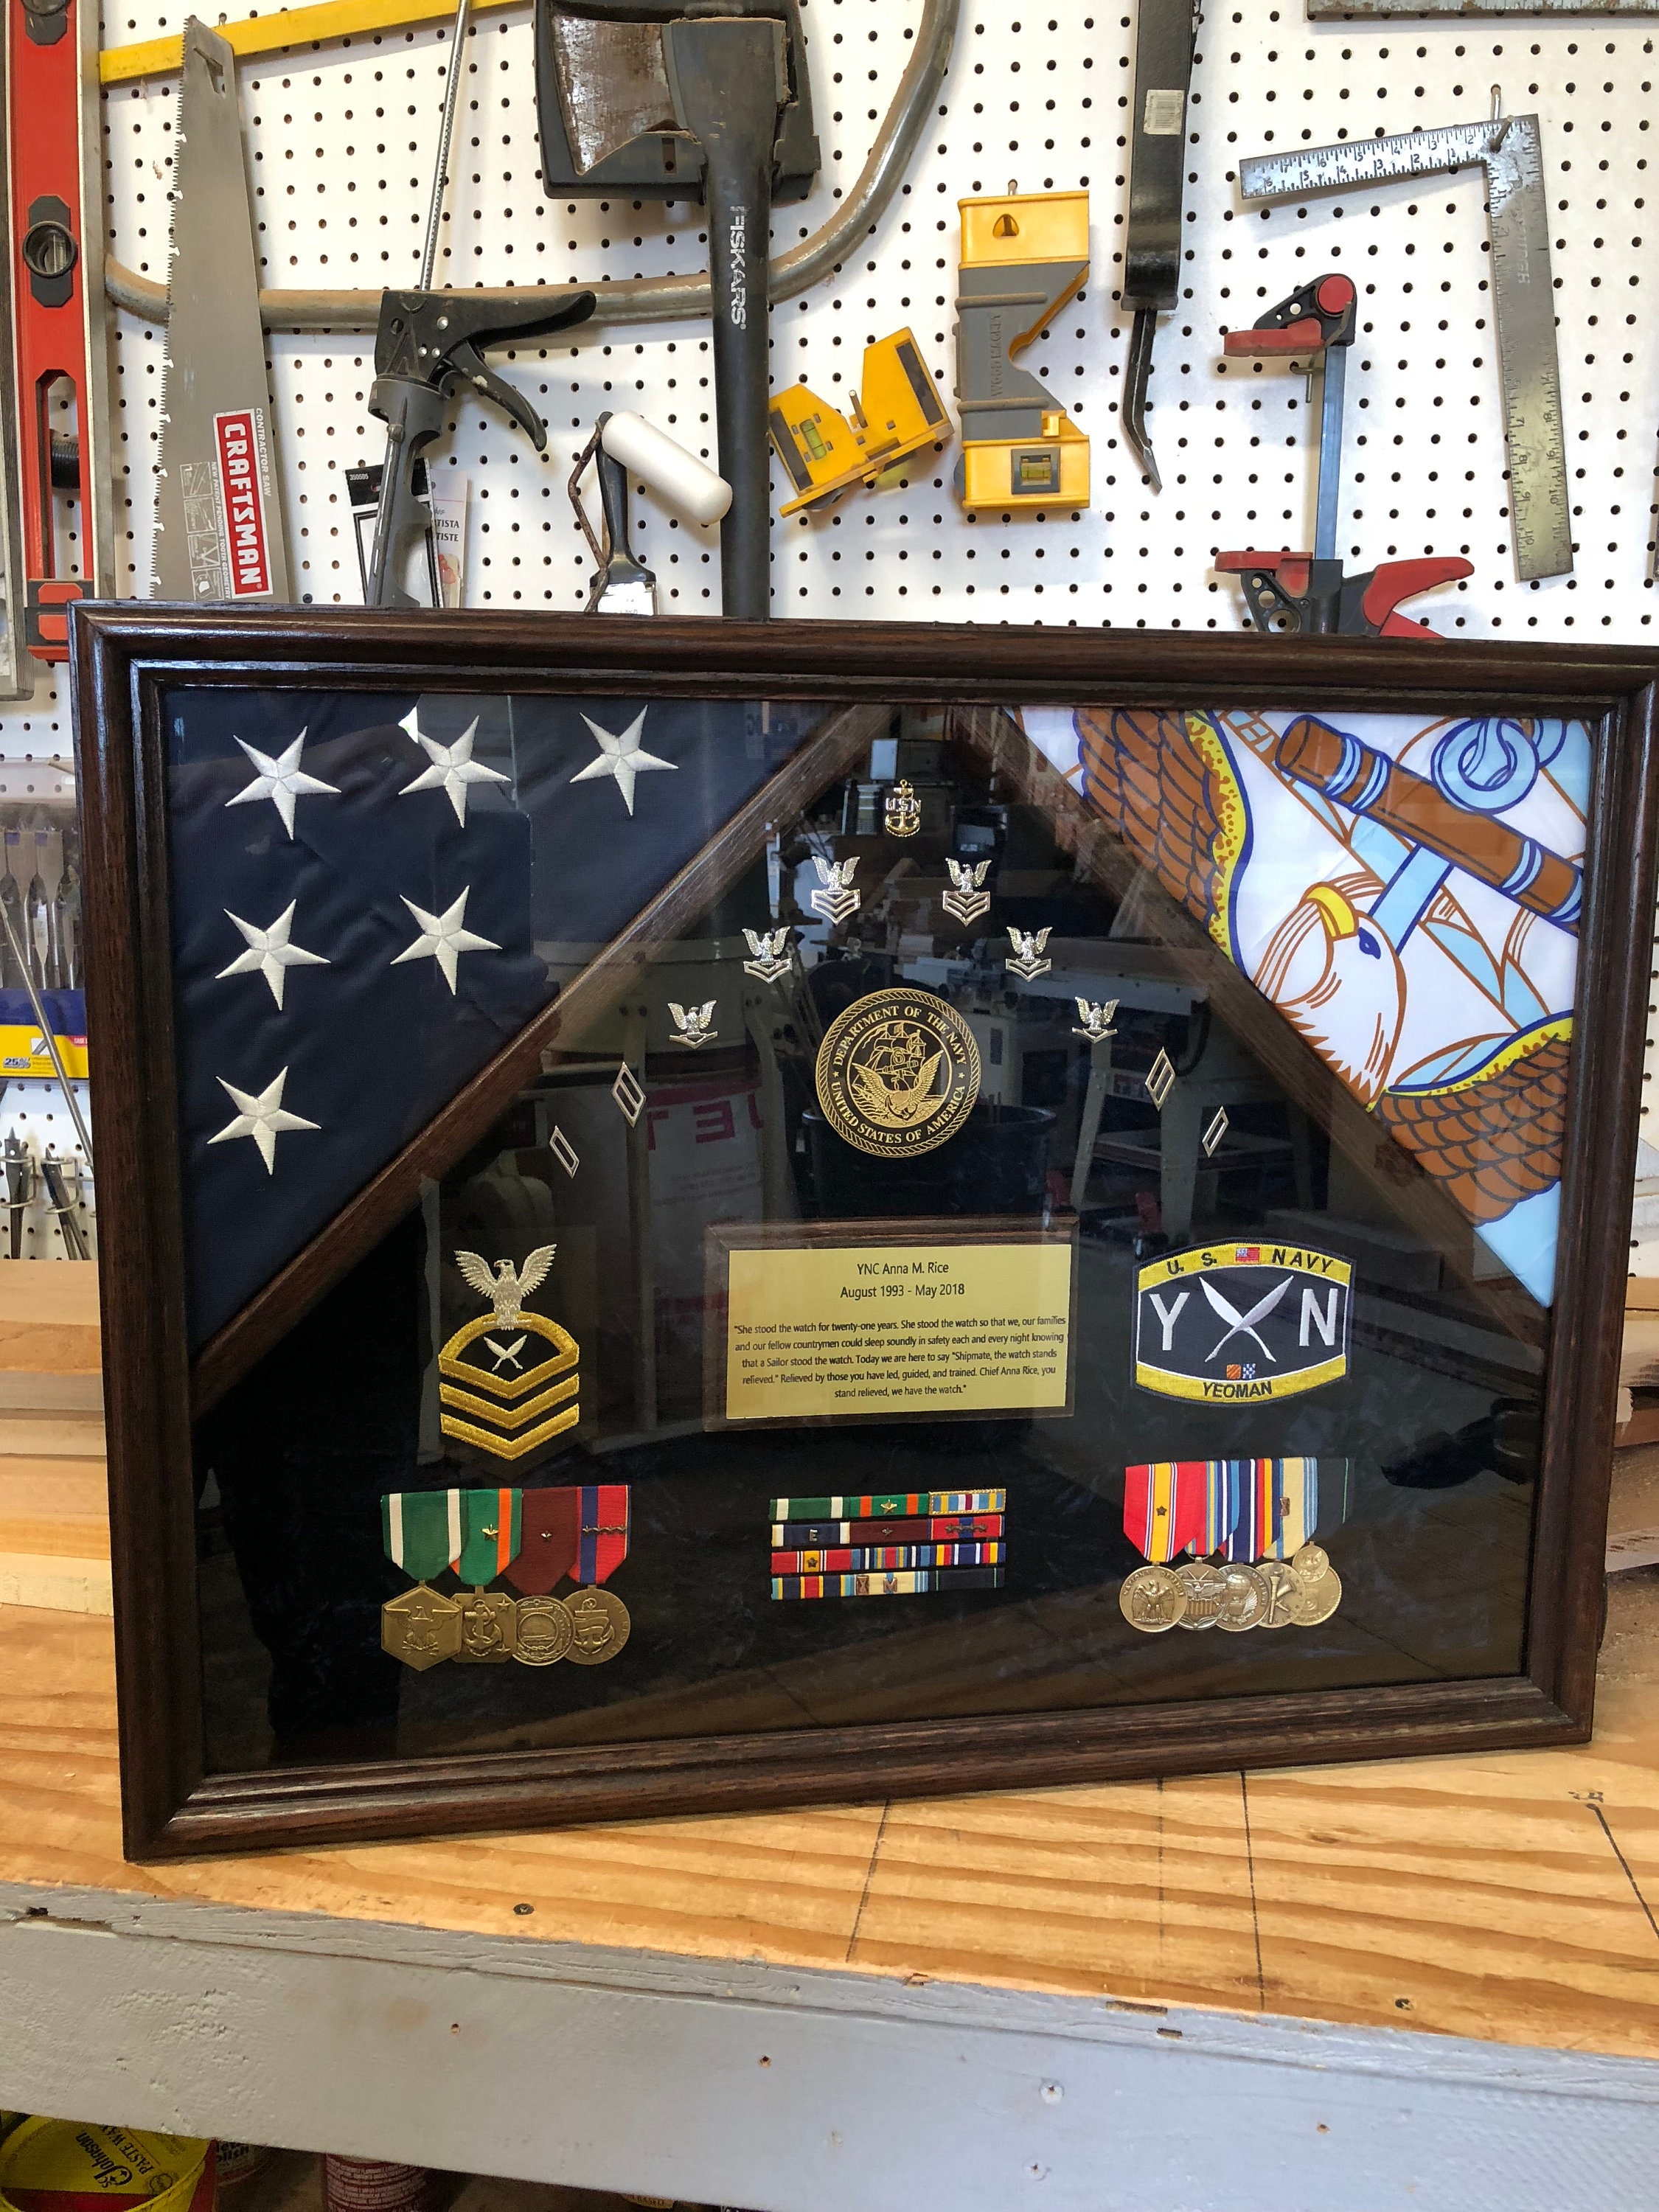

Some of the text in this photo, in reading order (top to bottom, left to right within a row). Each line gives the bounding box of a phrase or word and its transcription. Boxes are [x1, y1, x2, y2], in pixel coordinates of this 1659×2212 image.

[730, 206, 746, 325] FISKARS
[256, 408, 271, 496] CONTRACTOR SAW
[213, 479, 221, 504] PATENT
[225, 422, 262, 585] CRAFTSMAN
[215, 506, 224, 537] PENDING
[436, 519, 460, 529] TISTA
[437, 532, 459, 542] TISTE
[221, 562, 231, 599] GEOMETRY
[886, 797, 922, 813] USN
[832, 1005, 967, 1066] DEPARTMENT OF THE NAVY
[831, 1081, 966, 1144] UNITED STATES OF AMERICA
[858, 1262, 949, 1275] YNC Anna M. Rice
[1272, 1248, 1334, 1273] NAVY
[841, 1286, 877, 1300] August
[881, 1285, 904, 1296] 1993
[916, 1284, 936, 1298] May
[940, 1284, 964, 1295] 2018
[754, 1324, 776, 1333] stood
[779, 1324, 791, 1332] the
[793, 1323, 815, 1332] watch
[818, 1322, 829, 1332] for
[901, 1320, 915, 1329] She
[917, 1319, 939, 1328] stood
[942, 1318, 953, 1327] the
[956, 1318, 977, 1327] watch
[990, 1317, 1005, 1326] that
[1008, 1318, 1020, 1327] we,
[1037, 1316, 1065, 1325] families
[1149, 1288, 1338, 1351] Y N
[735, 1333, 1064, 1351] and our fellow countrymen could sleep soundly in safety each and every night knowing
[742, 1359, 758, 1368] that
[767, 1357, 788, 1367] Sailor
[790, 1357, 813, 1366] stood
[815, 1356, 827, 1365] the
[830, 1355, 854, 1364] watch.
[856, 1354, 879, 1365] Today
[908, 1353, 925, 1362] here
[928, 1353, 935, 1361] to
[938, 1354, 950, 1363] say
[995, 1351, 1006, 1360] the
[1009, 1349, 1030, 1359] watch
[1033, 1349, 1057, 1358] stands
[781, 1374, 813, 1382] Relieved
[815, 1373, 824, 1382] by
[827, 1371, 848, 1381] those
[850, 1373, 864, 1382] you
[867, 1371, 885, 1380] have
[902, 1368, 931, 1380] guided,
[933, 1368, 947, 1377] and
[980, 1366, 999, 1376] Chief
[1001, 1366, 1020, 1375] Anna
[1042, 1366, 1056, 1376] you
[835, 1388, 856, 1398] stand
[892, 1387, 902, 1396] we
[905, 1385, 922, 1395] have
[925, 1385, 936, 1394] the
[1203, 1381, 1273, 1398] YEOMAN
